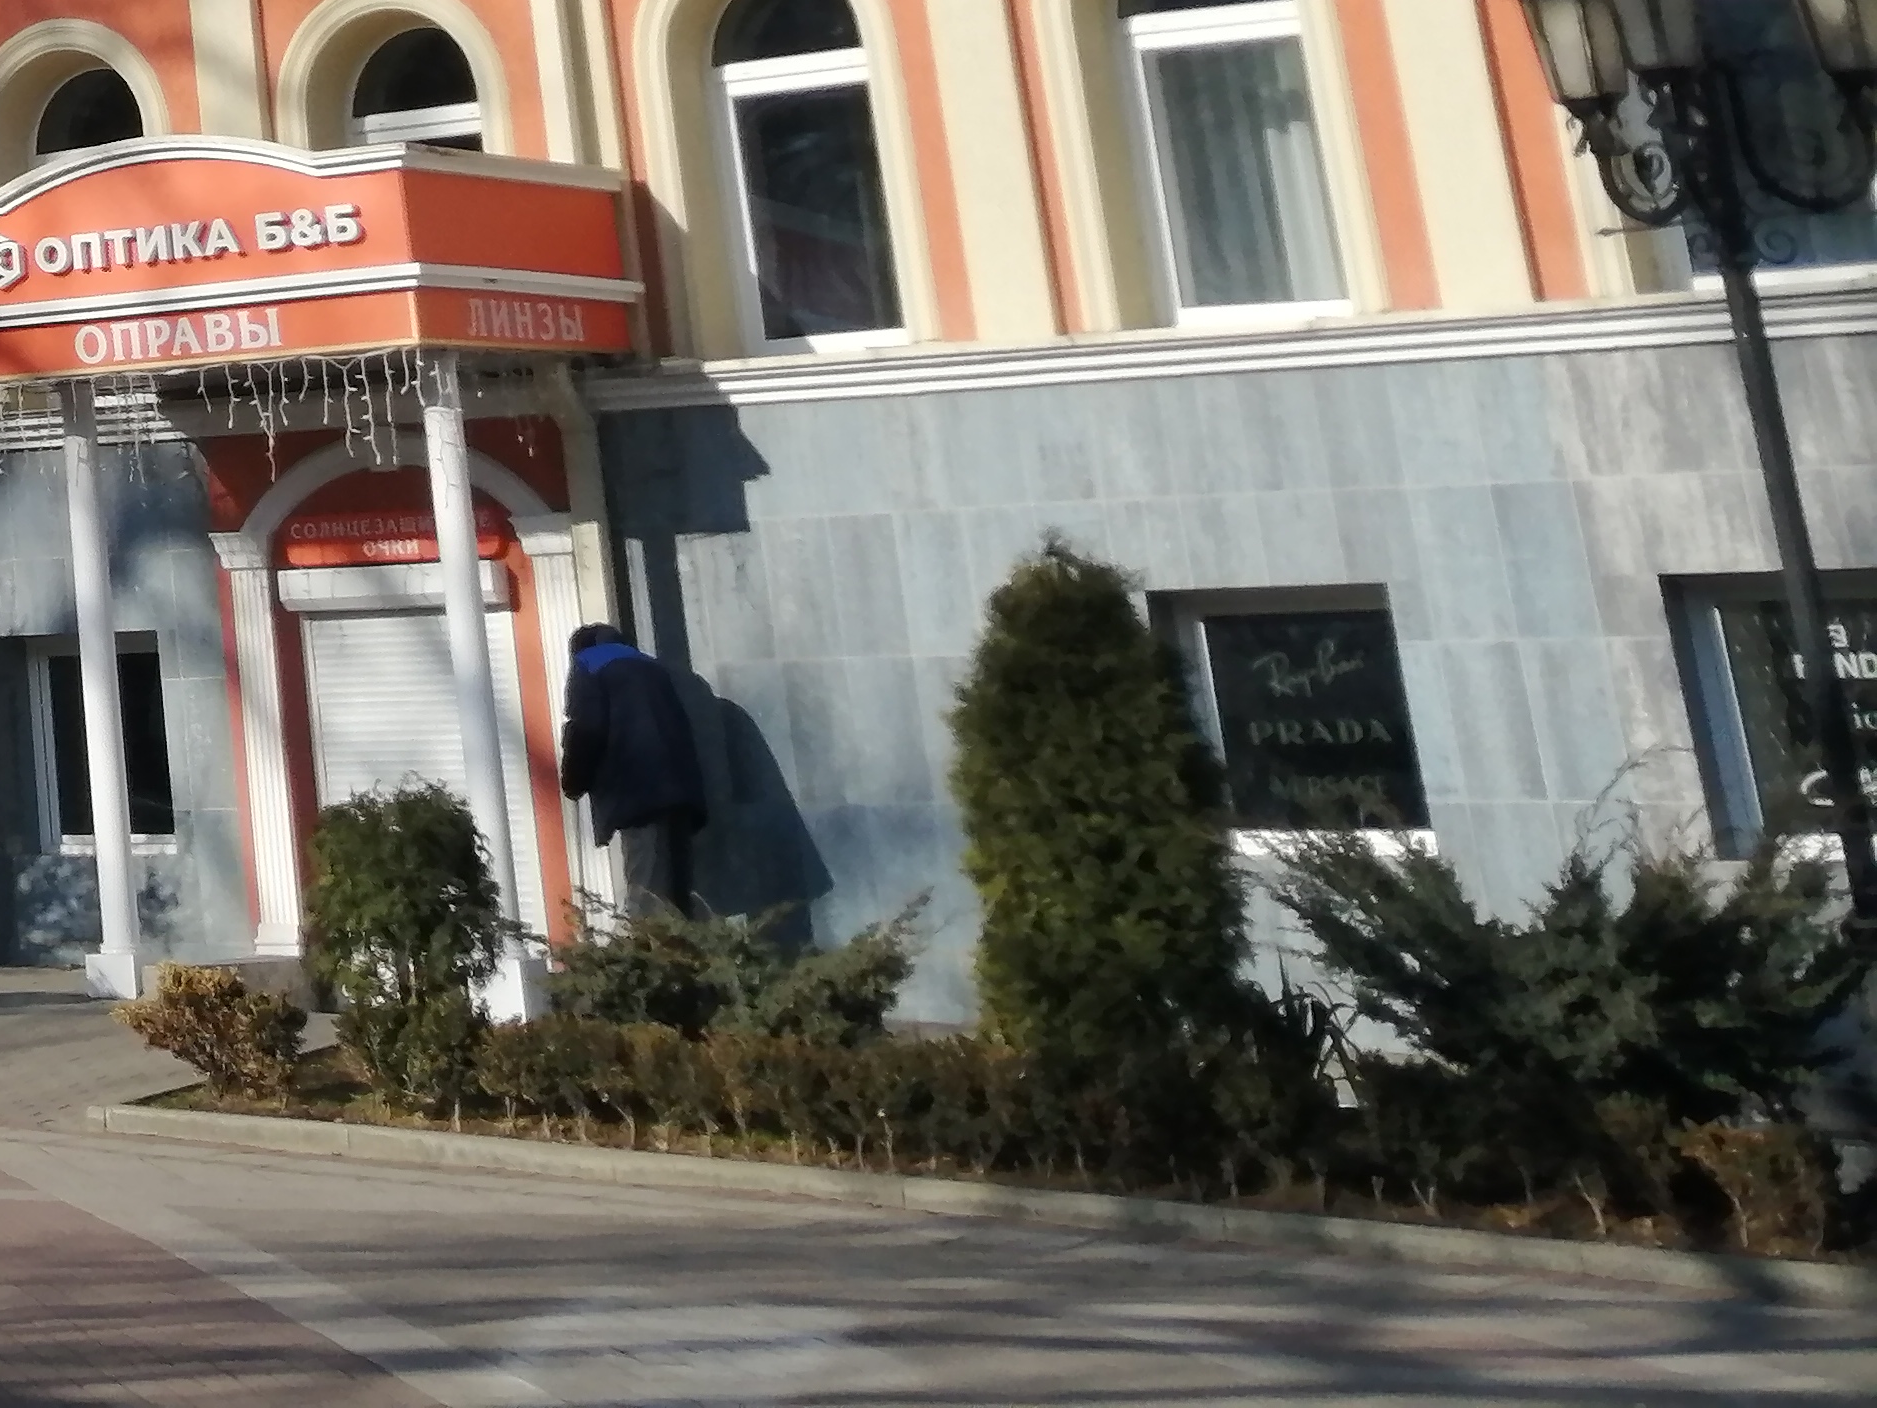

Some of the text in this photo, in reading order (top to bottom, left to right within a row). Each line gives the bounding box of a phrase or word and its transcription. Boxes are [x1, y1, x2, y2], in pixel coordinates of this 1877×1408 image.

[34, 203, 363, 274] ОПТИКА Б&Б
[73, 307, 284, 366] ОПРАВЫ
[467, 298, 586, 342] ЛИНЗЫ
[362, 539, 419, 558] ОЧКИ
[1248, 718, 1393, 746] PRADA
